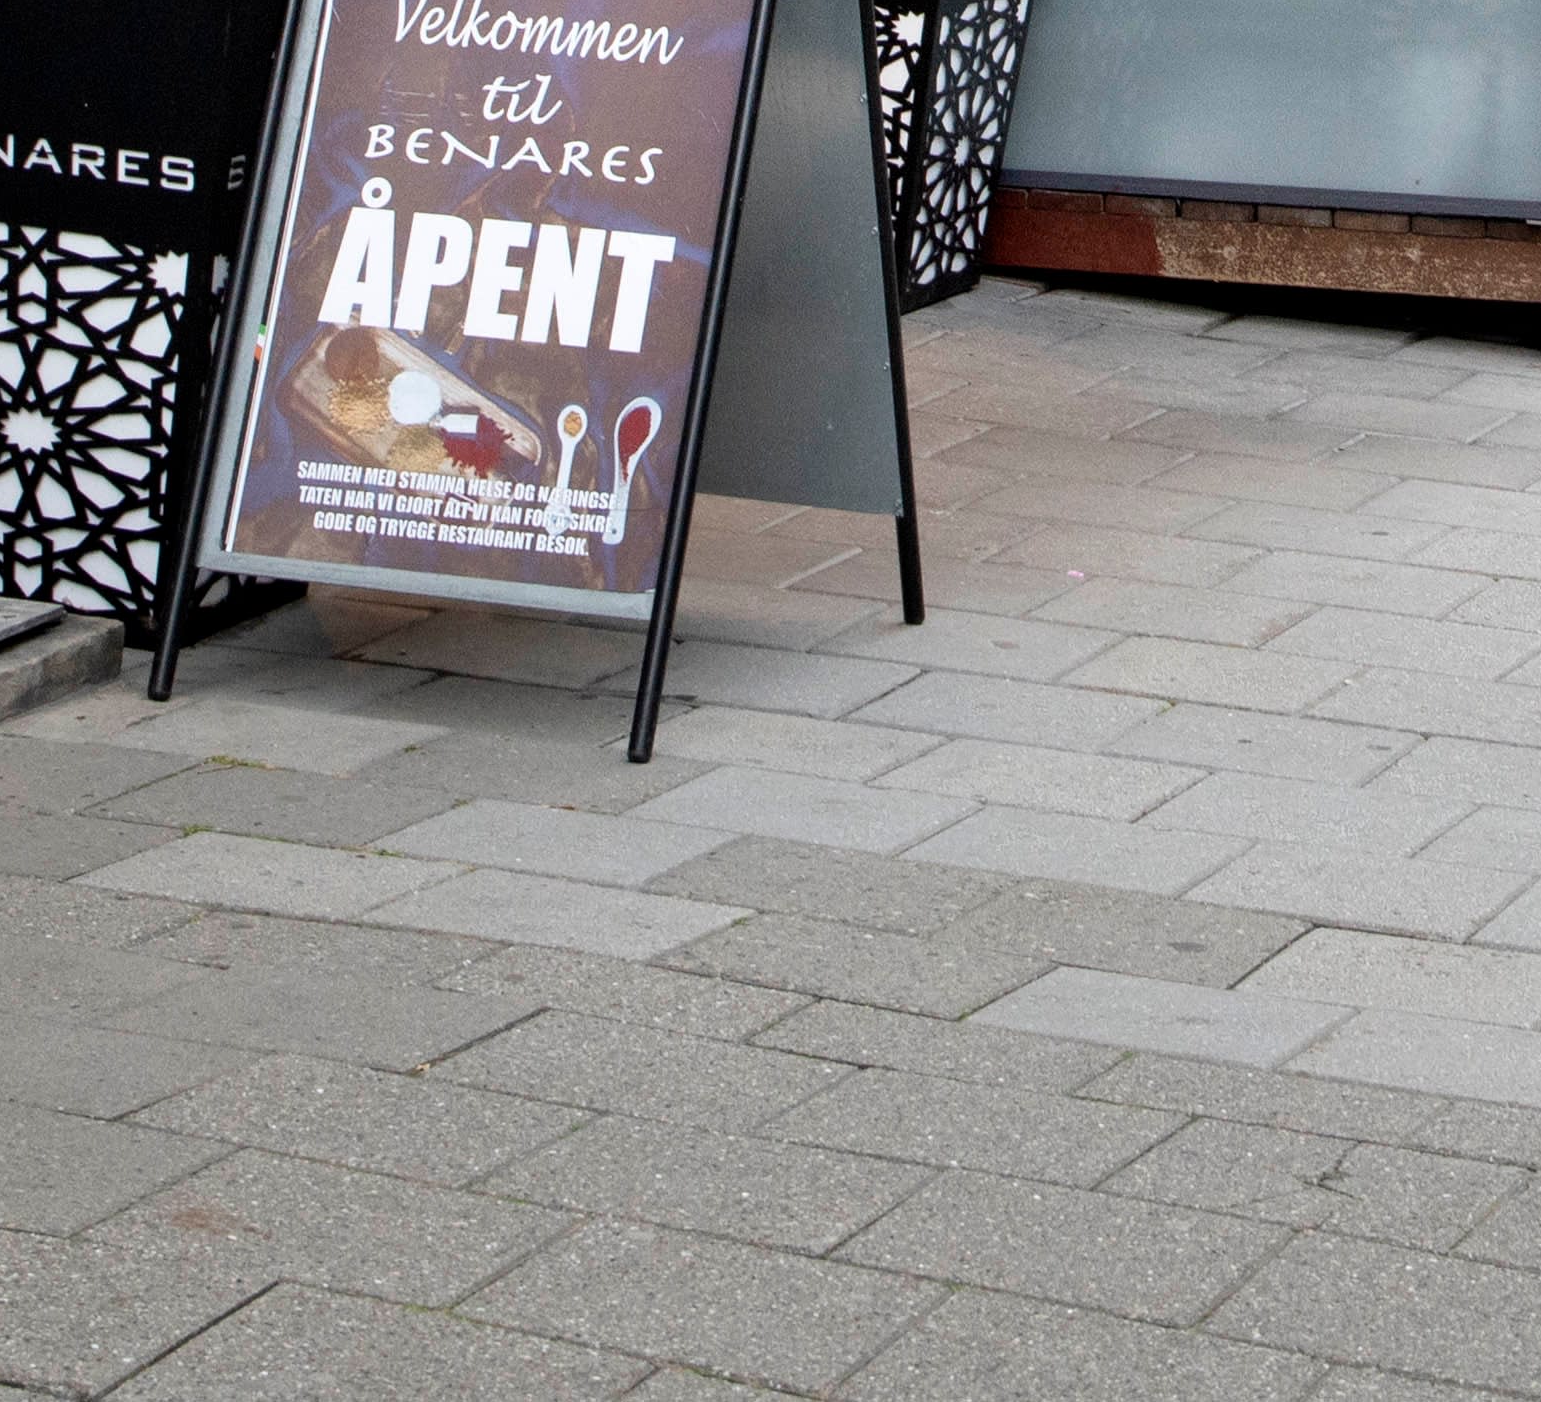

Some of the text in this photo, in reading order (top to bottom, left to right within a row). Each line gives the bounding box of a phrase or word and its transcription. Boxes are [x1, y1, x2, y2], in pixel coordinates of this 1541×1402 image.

[482, 75, 562, 126] til
[364, 123, 664, 186] BENARES
[317, 176, 677, 355] ÅPENT
[297, 460, 362, 484] SAMMEN
[364, 467, 397, 488] MED
[398, 470, 466, 496] STAMINA
[467, 478, 512, 501] HELSE
[513, 483, 536, 502] OG
[299, 486, 342, 507] TATEN
[344, 490, 376, 510] HAR
[377, 492, 393, 512] VI
[395, 496, 443, 517] GJORT
[443, 498, 468, 520] ALT
[471, 502, 488, 522] VI
[490, 505, 522, 526] KAN
[313, 510, 355, 532] GODE
[355, 515, 377, 534] OG
[379, 517, 436, 541] TRYGGE
[437, 523, 535, 550] RESTAURANT
